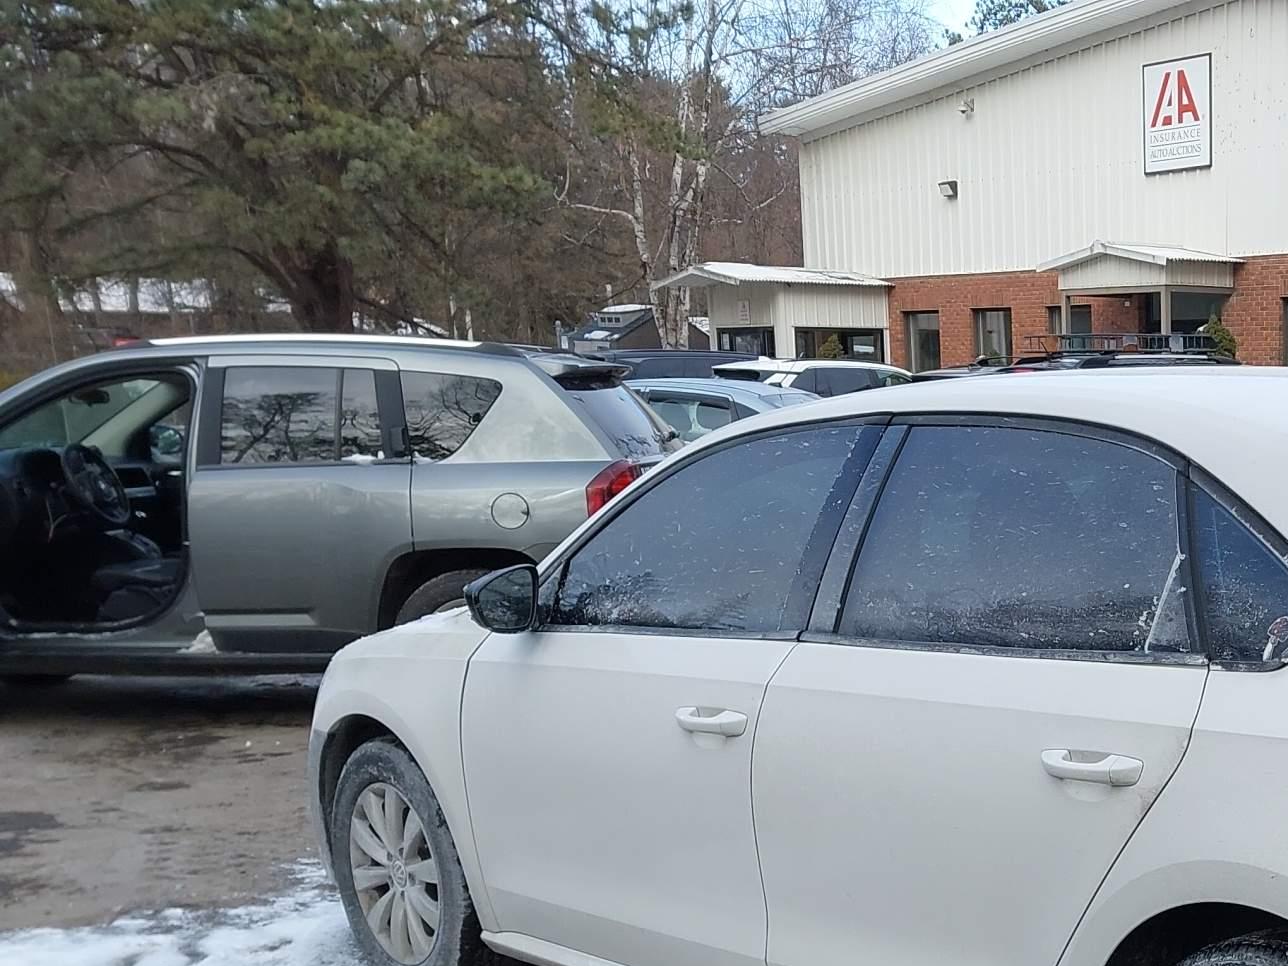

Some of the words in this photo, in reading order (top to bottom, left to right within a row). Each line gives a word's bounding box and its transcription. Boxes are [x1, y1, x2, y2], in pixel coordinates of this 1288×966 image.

[1150, 128, 1201, 144] INSURANCE
[1150, 146, 1168, 159] AUTO
[1168, 144, 1202, 156] AUCTIONS
